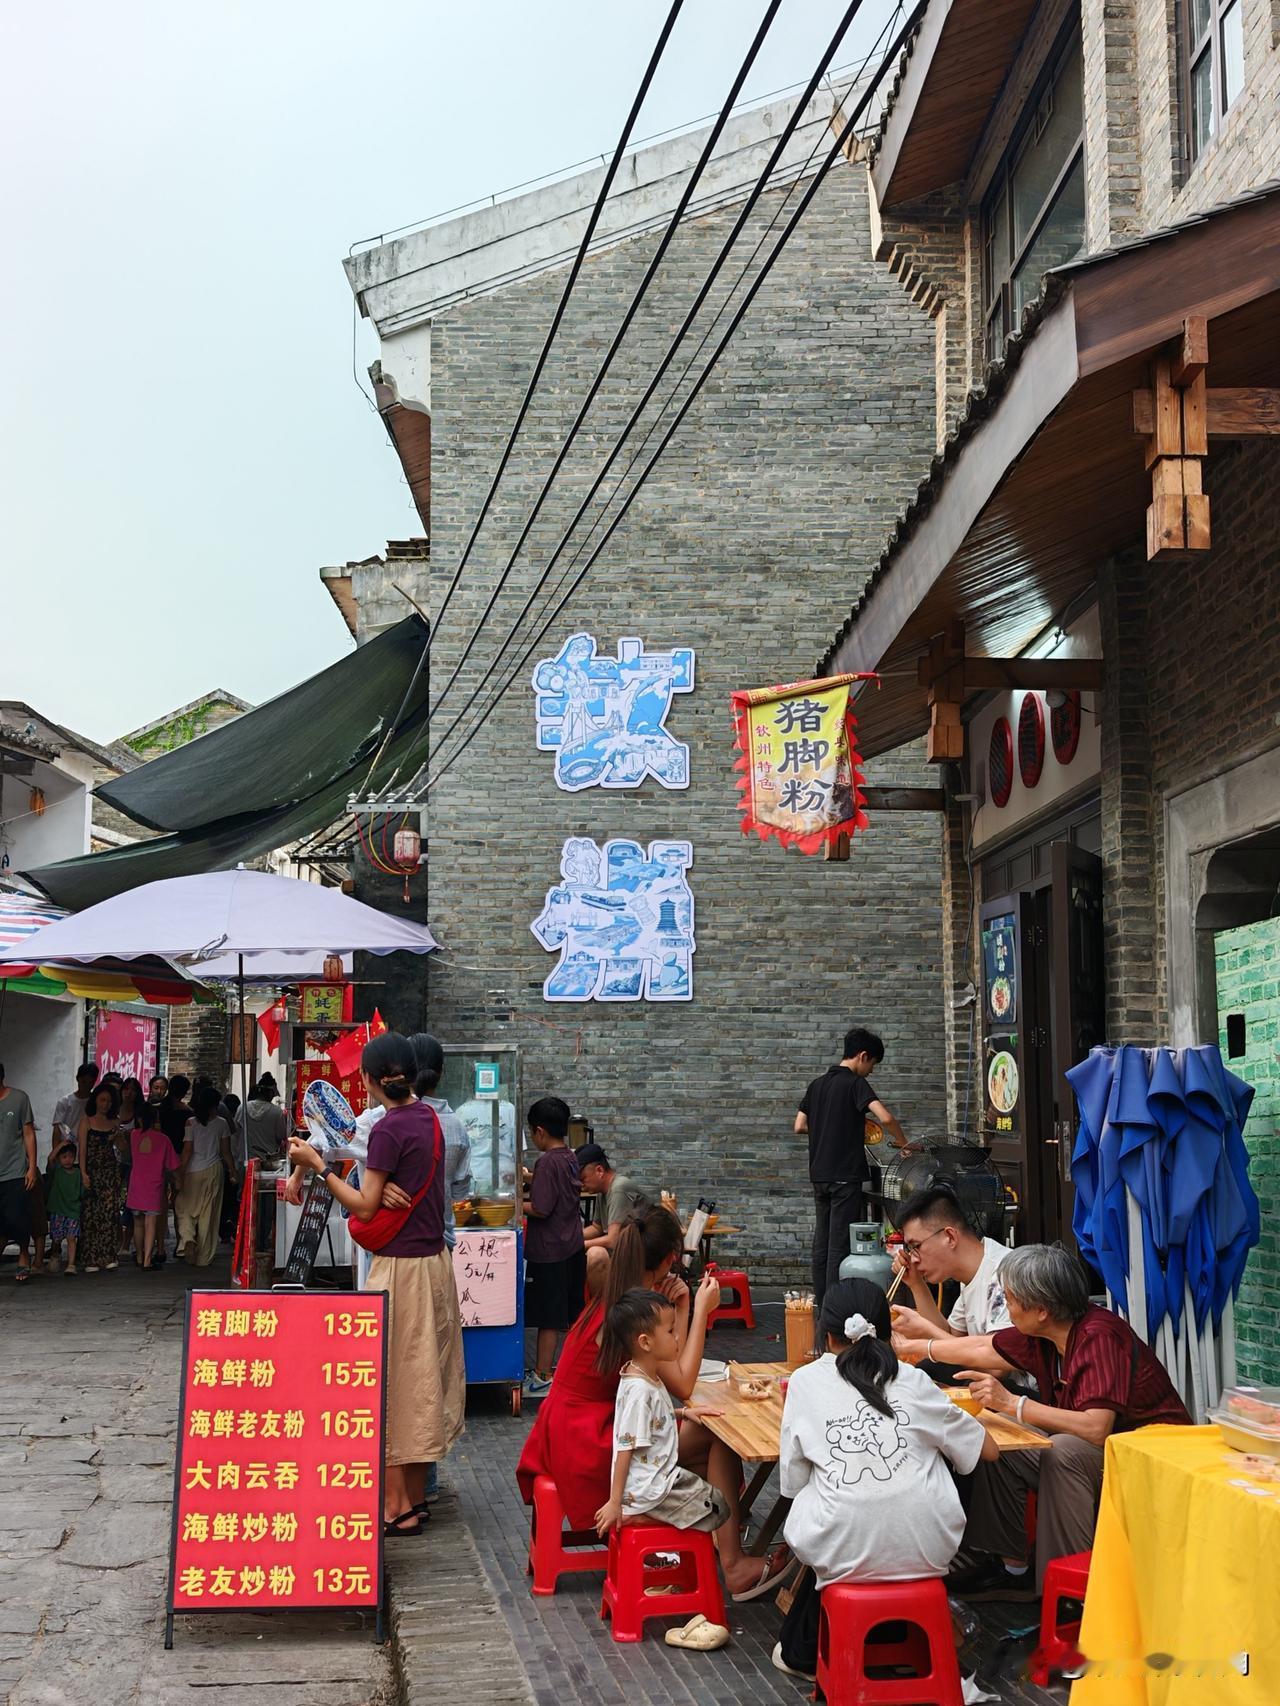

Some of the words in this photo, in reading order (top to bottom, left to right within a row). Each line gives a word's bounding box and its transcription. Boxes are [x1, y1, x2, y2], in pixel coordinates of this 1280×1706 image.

[755, 724, 776, 792] 钦州特色
[774, 699, 834, 814] 猪脚粉
[197, 1310, 278, 1337] 猪脚粉
[325, 1312, 377, 1337] 13元
[193, 1359, 275, 1387] 海鲜粉
[323, 1361, 376, 1386] 15元
[190, 1410, 304, 1438] 海鲜老友粉
[321, 1410, 374, 1438] 16元
[186, 1461, 299, 1489] 大肉云吞
[317, 1462, 372, 1488] 12元
[183, 1513, 297, 1542] 海鲜炒粉
[316, 1514, 372, 1540] 16元
[179, 1566, 295, 1595] 老友炒粉
[314, 1567, 370, 1594] 13元
